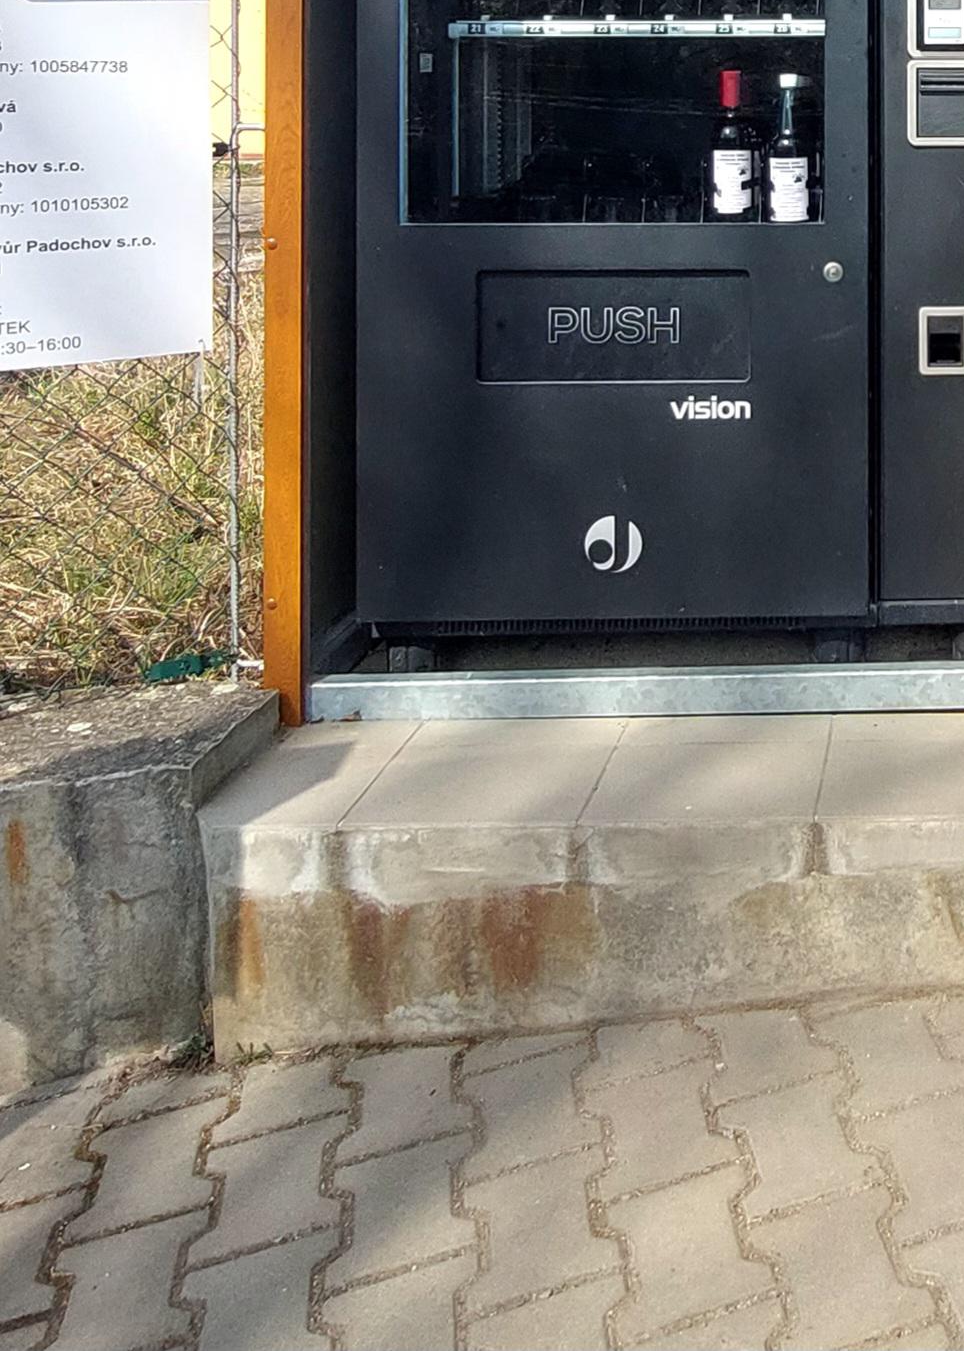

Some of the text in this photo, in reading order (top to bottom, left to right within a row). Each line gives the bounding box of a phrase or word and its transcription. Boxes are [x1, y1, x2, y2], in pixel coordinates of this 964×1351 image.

[30, 60, 128, 73] 1005847738
[43, 161, 85, 172] s.r.o.
[0, 196, 129, 217] ny: 1010105302
[0, 236, 156, 254] ůr Padochov s.r.o.
[548, 306, 680, 344] PUSH
[670, 395, 751, 420] vision
